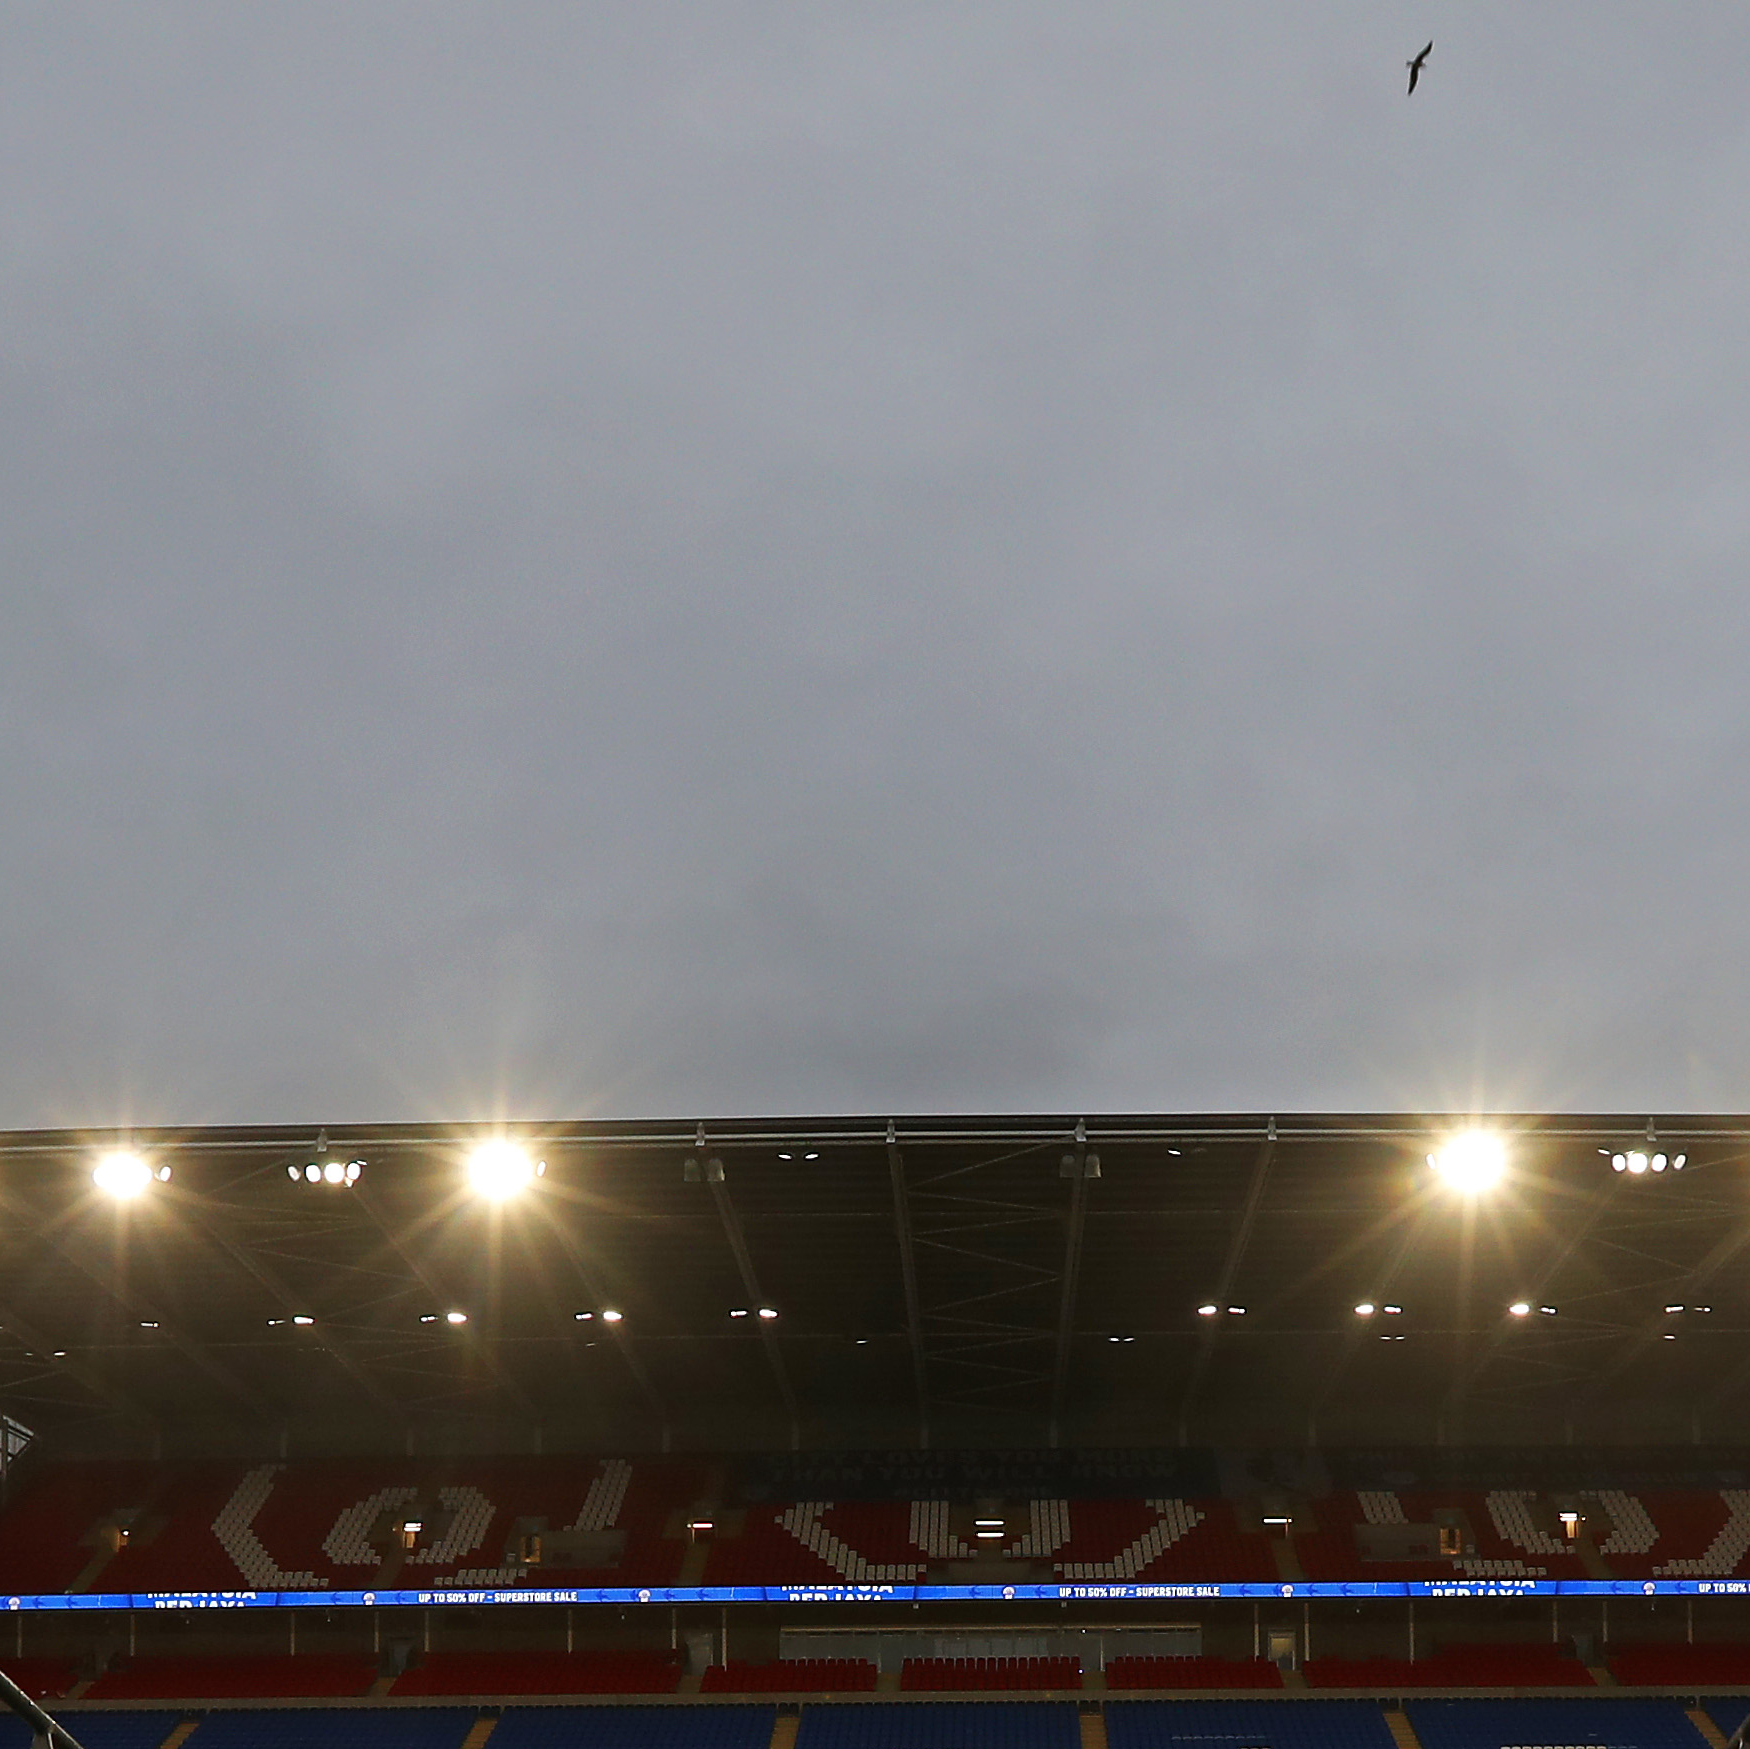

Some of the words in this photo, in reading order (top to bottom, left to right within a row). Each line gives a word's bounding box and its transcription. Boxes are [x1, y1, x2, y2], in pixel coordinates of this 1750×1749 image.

[1059, 1587, 1073, 1597] UP
[1074, 1587, 1086, 1597] TO
[1088, 1587, 1108, 1597] 50%
[1110, 1587, 1127, 1597] OFF
[1136, 1587, 1195, 1597] SUPERSTORE
[1196, 1587, 1220, 1597] SALE
[1698, 1583, 1710, 1593] UP
[1714, 1583, 1725, 1593] TO
[1727, 1583, 1747, 1593] 50%
[418, 1593, 432, 1603] UP
[433, 1593, 445, 1603] TO
[447, 1593, 467, 1603] 50%
[468, 1593, 486, 1602] OFF
[494, 1592, 552, 1602] SUPERSTORE
[554, 1592, 578, 1602] SALE
